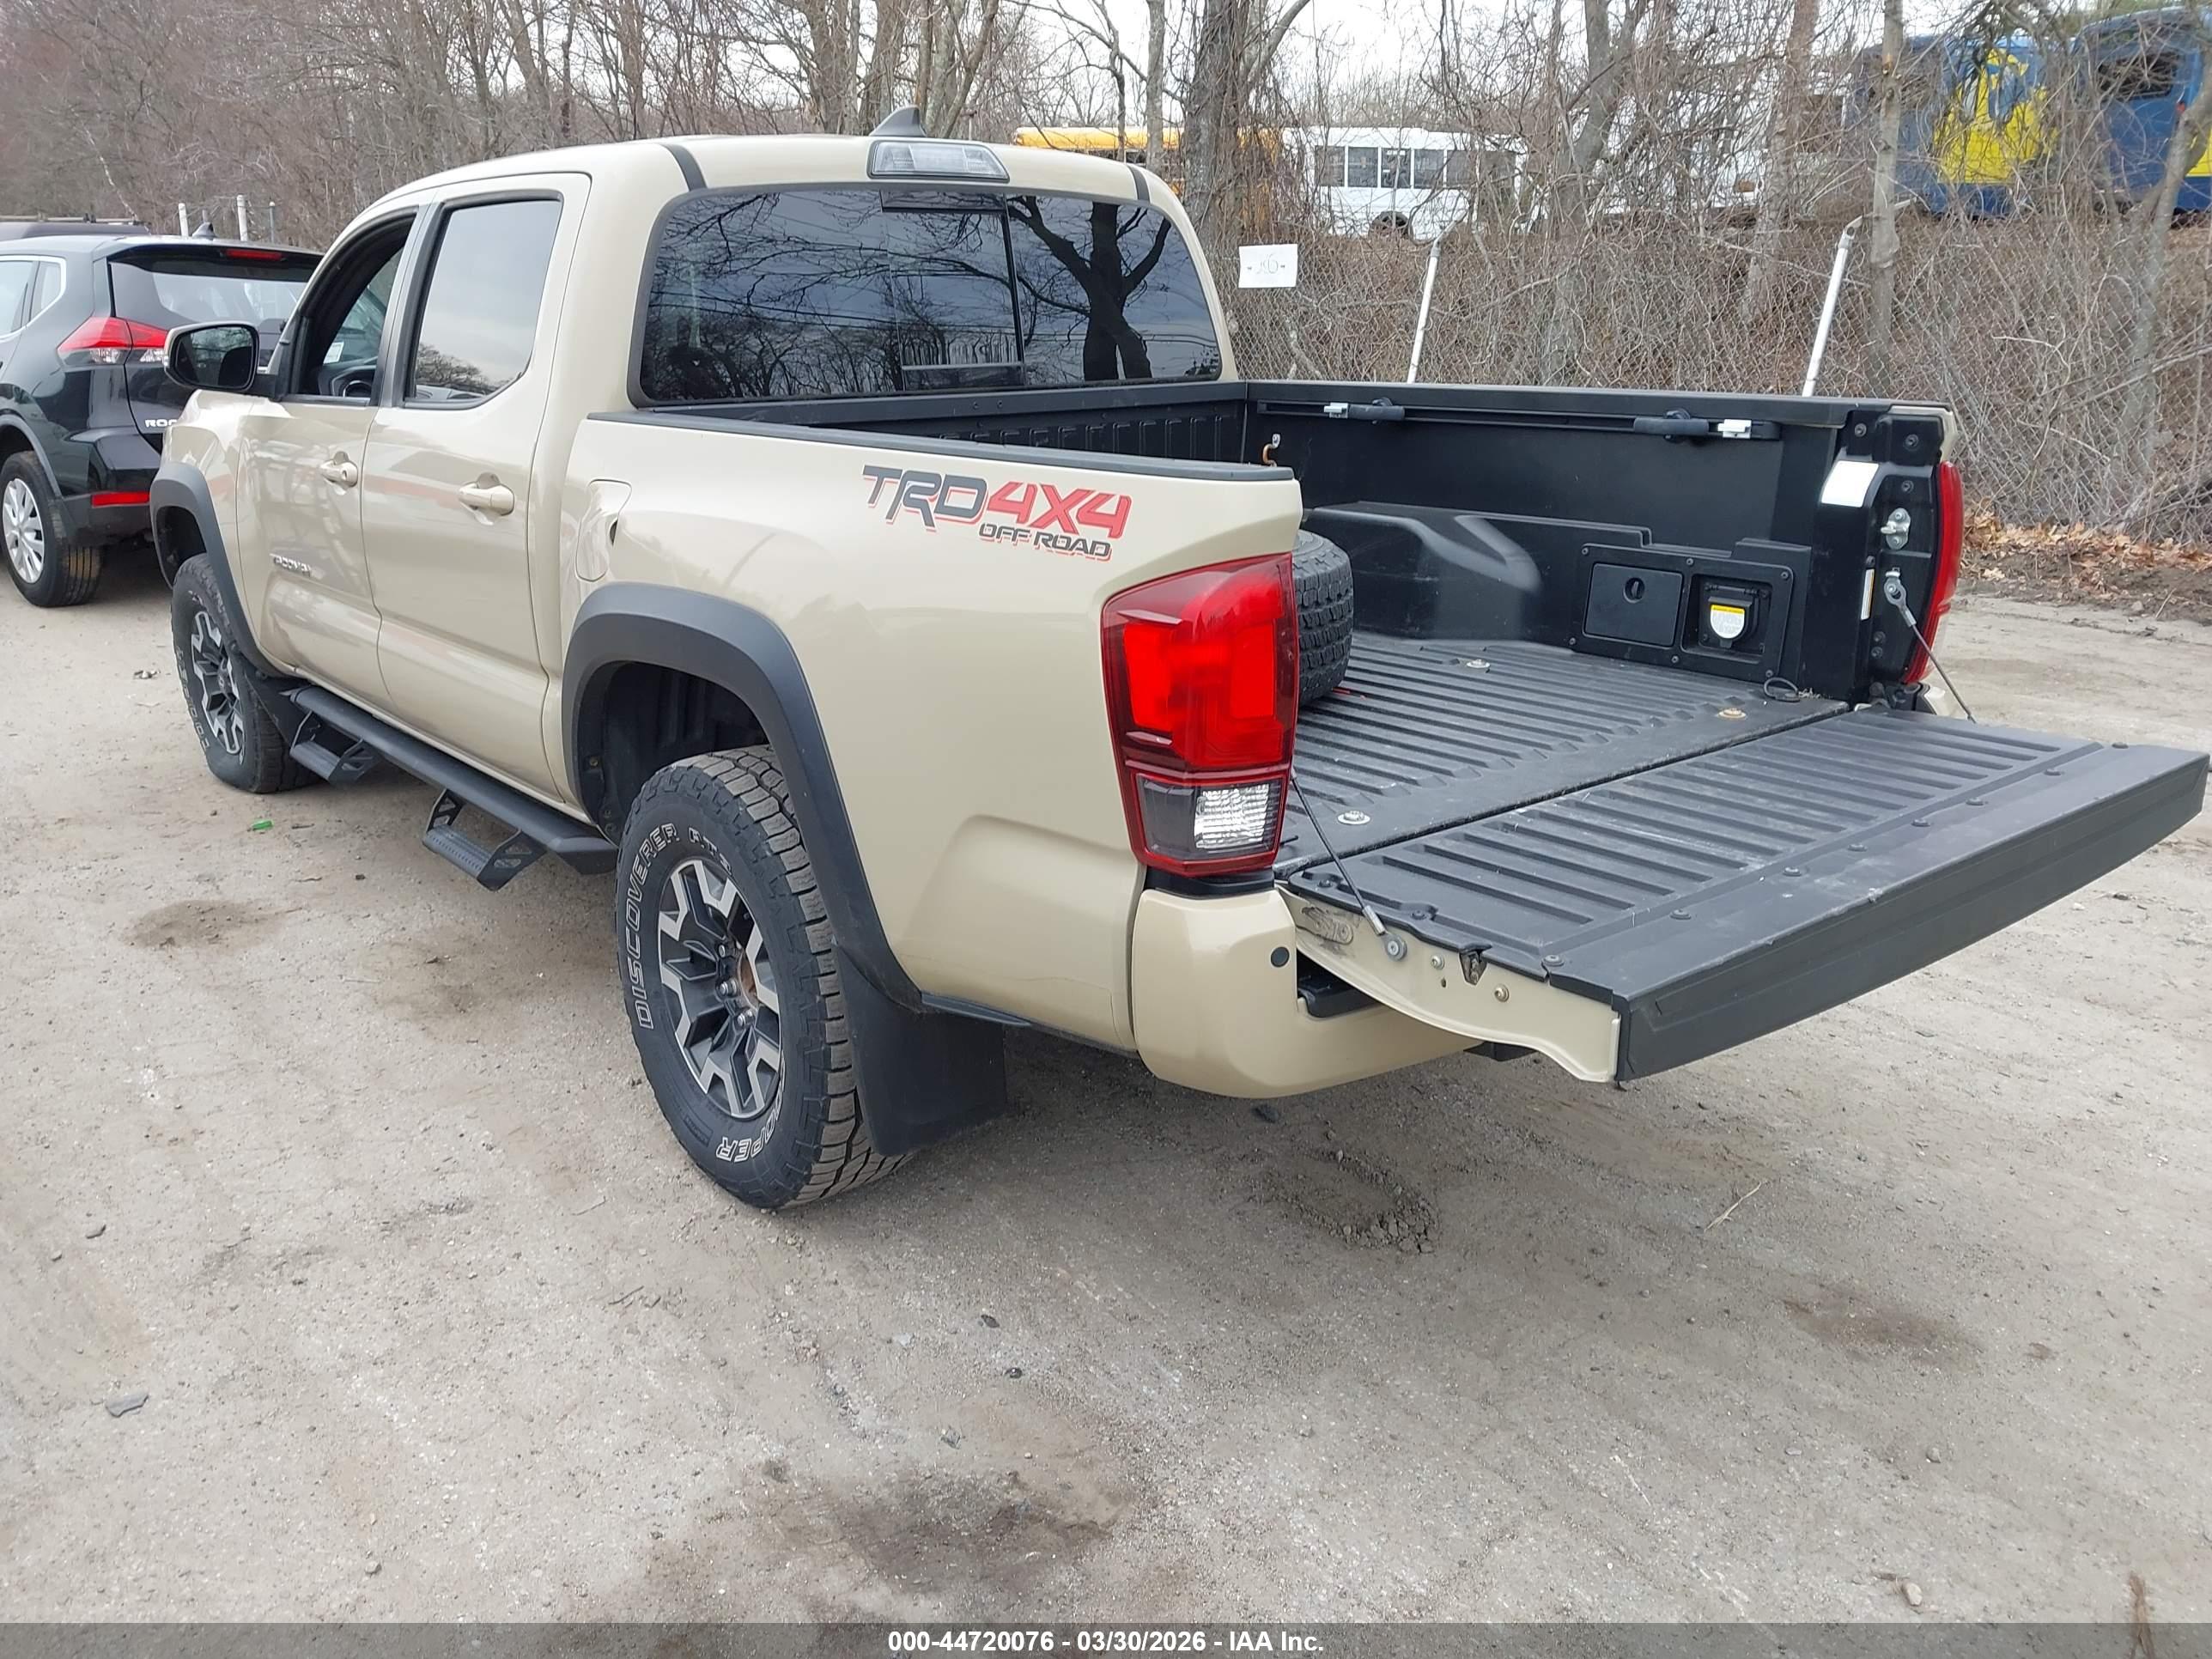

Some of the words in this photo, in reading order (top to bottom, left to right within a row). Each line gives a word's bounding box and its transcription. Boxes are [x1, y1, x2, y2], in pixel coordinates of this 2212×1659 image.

[862, 465, 988, 532] TRD
[988, 481, 1133, 539] 4X4
[978, 523, 1032, 546] OFF
[1033, 531, 1113, 562] ROAD
[625, 822, 680, 1030] DISCOVERER
